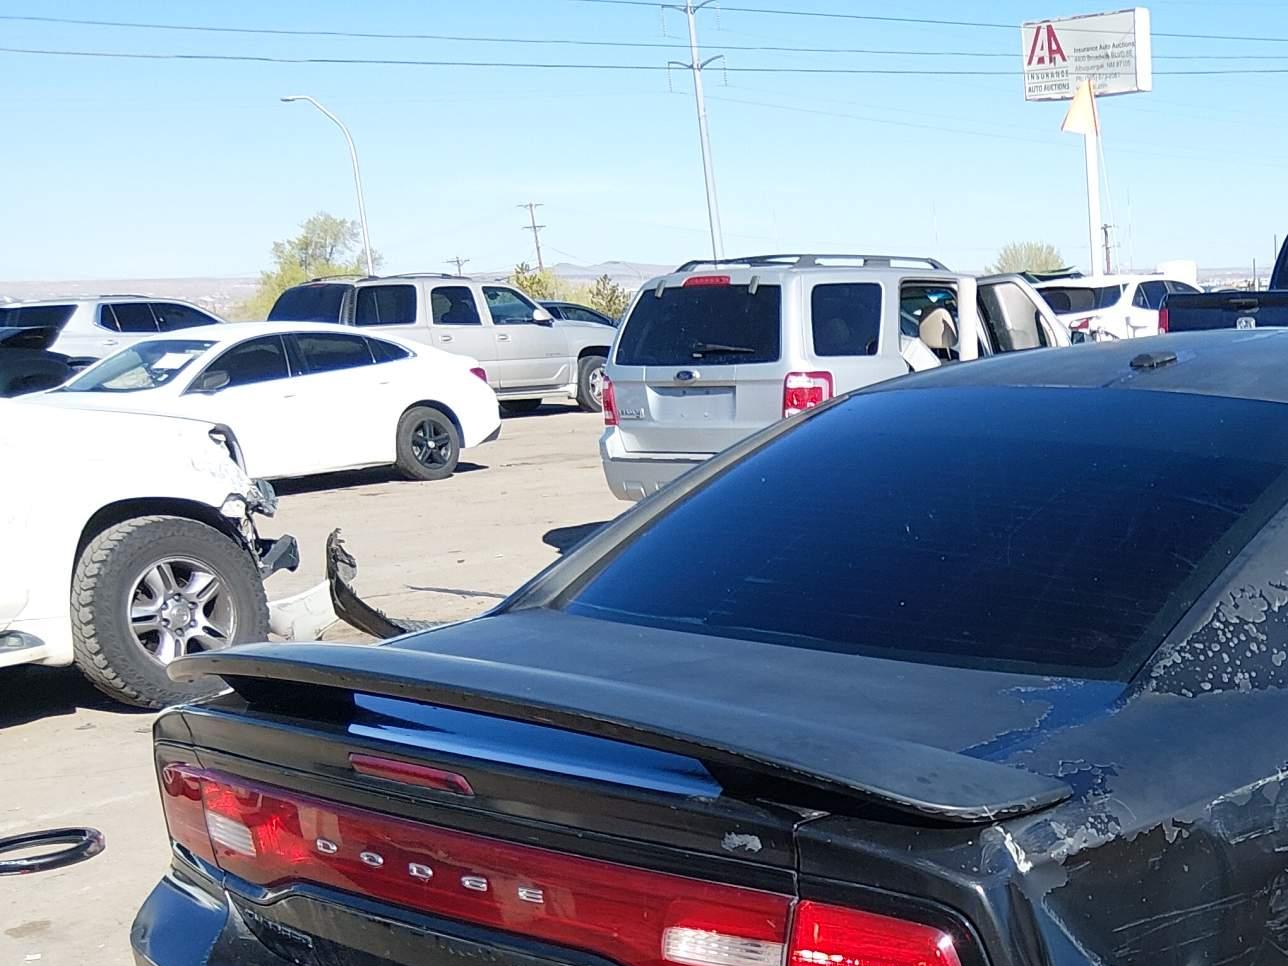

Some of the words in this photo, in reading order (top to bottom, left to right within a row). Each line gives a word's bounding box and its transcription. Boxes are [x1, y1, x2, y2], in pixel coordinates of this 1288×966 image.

[1027, 69, 1069, 80] INSURANCE
[1028, 84, 1043, 93] AUTO
[1044, 82, 1070, 91] AUCTIONS
[316, 838, 545, 905] DODGE
